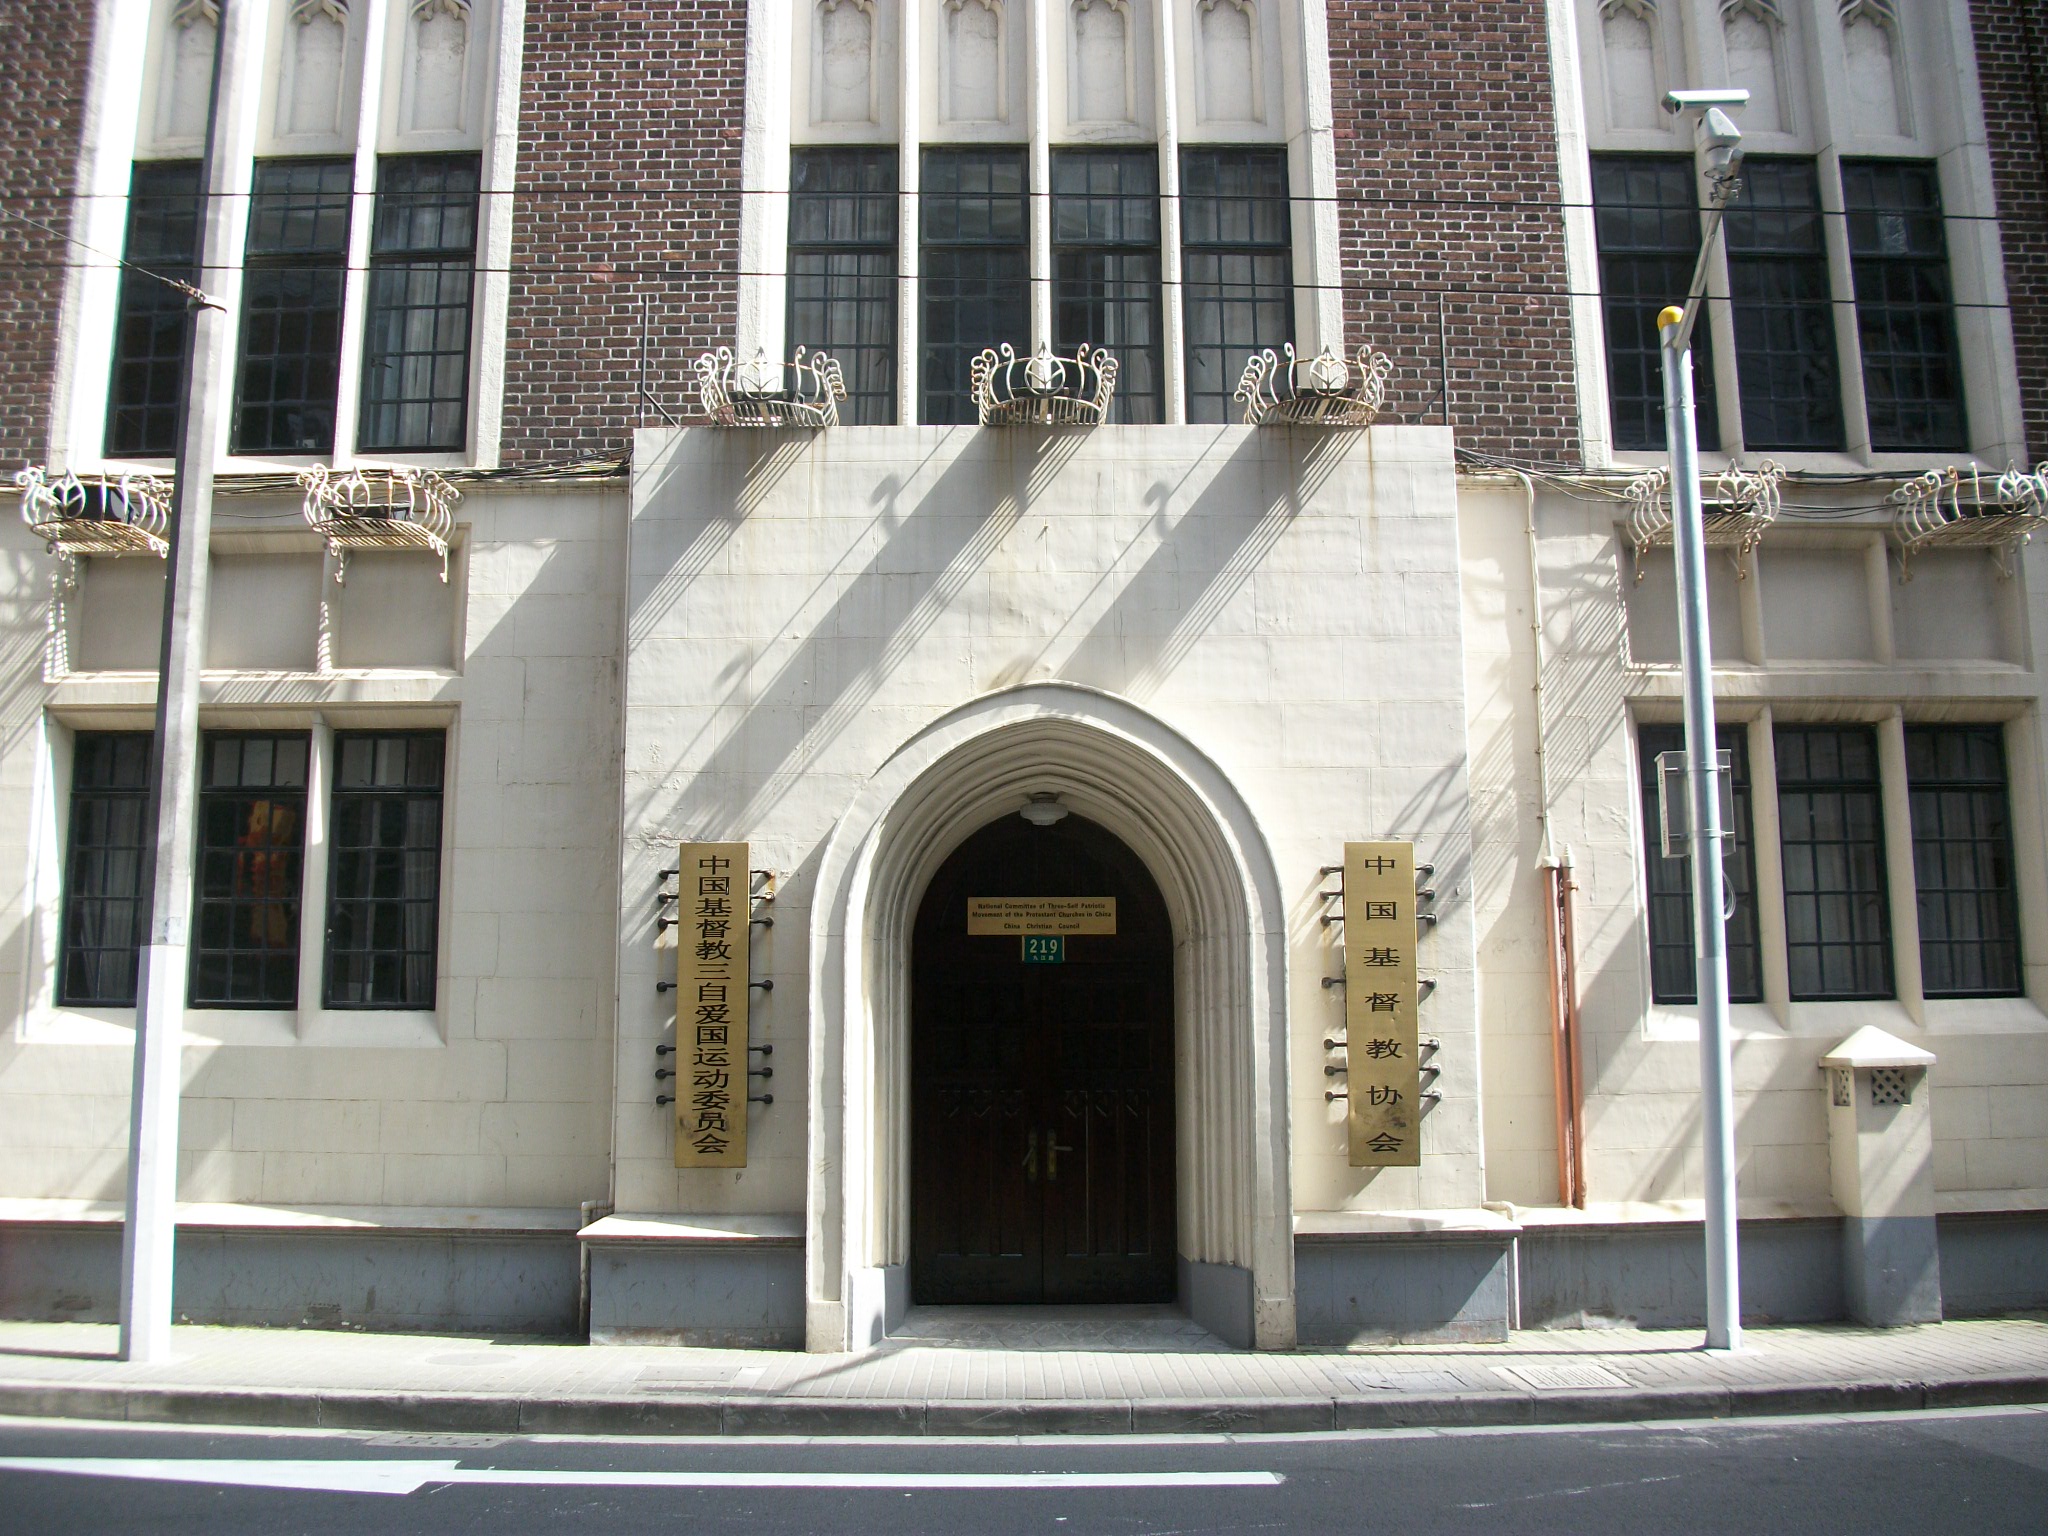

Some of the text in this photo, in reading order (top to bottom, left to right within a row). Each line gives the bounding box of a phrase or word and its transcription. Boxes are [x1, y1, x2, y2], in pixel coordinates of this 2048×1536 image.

[692, 855, 731, 1154] 中国基督教三自爱国运动委员会
[1029, 939, 1058, 954] 219
[1363, 855, 1404, 1153] 中国基督教协会
